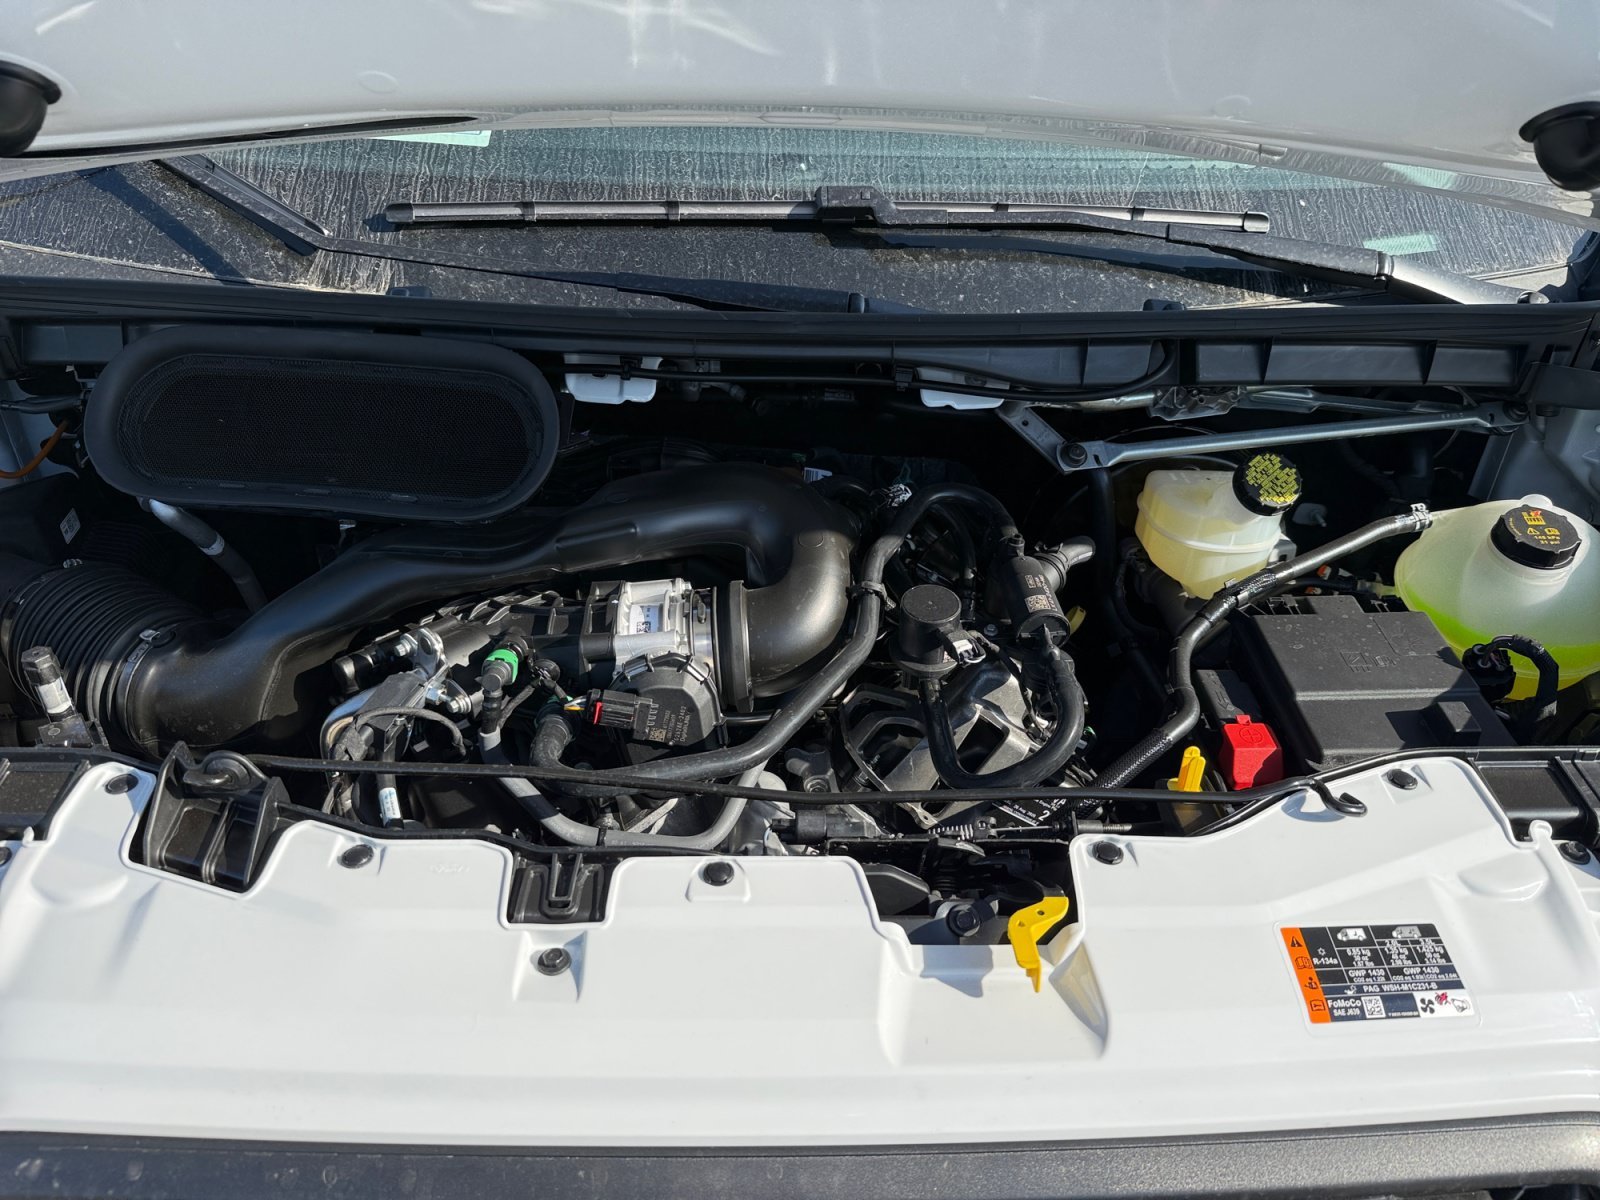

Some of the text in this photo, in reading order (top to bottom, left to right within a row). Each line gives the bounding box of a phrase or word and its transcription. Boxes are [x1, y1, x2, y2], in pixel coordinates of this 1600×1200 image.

[1038, 810, 1051, 822] 2
[1312, 956, 1338, 965] R-134a
[1348, 968, 1385, 977] GWP 1430
[1403, 966, 1440, 975] GWP 1430
[1362, 985, 1380, 993] PAG
[1327, 998, 1361, 1008] FoMoCo
[1333, 1008, 1346, 1016] SAE
